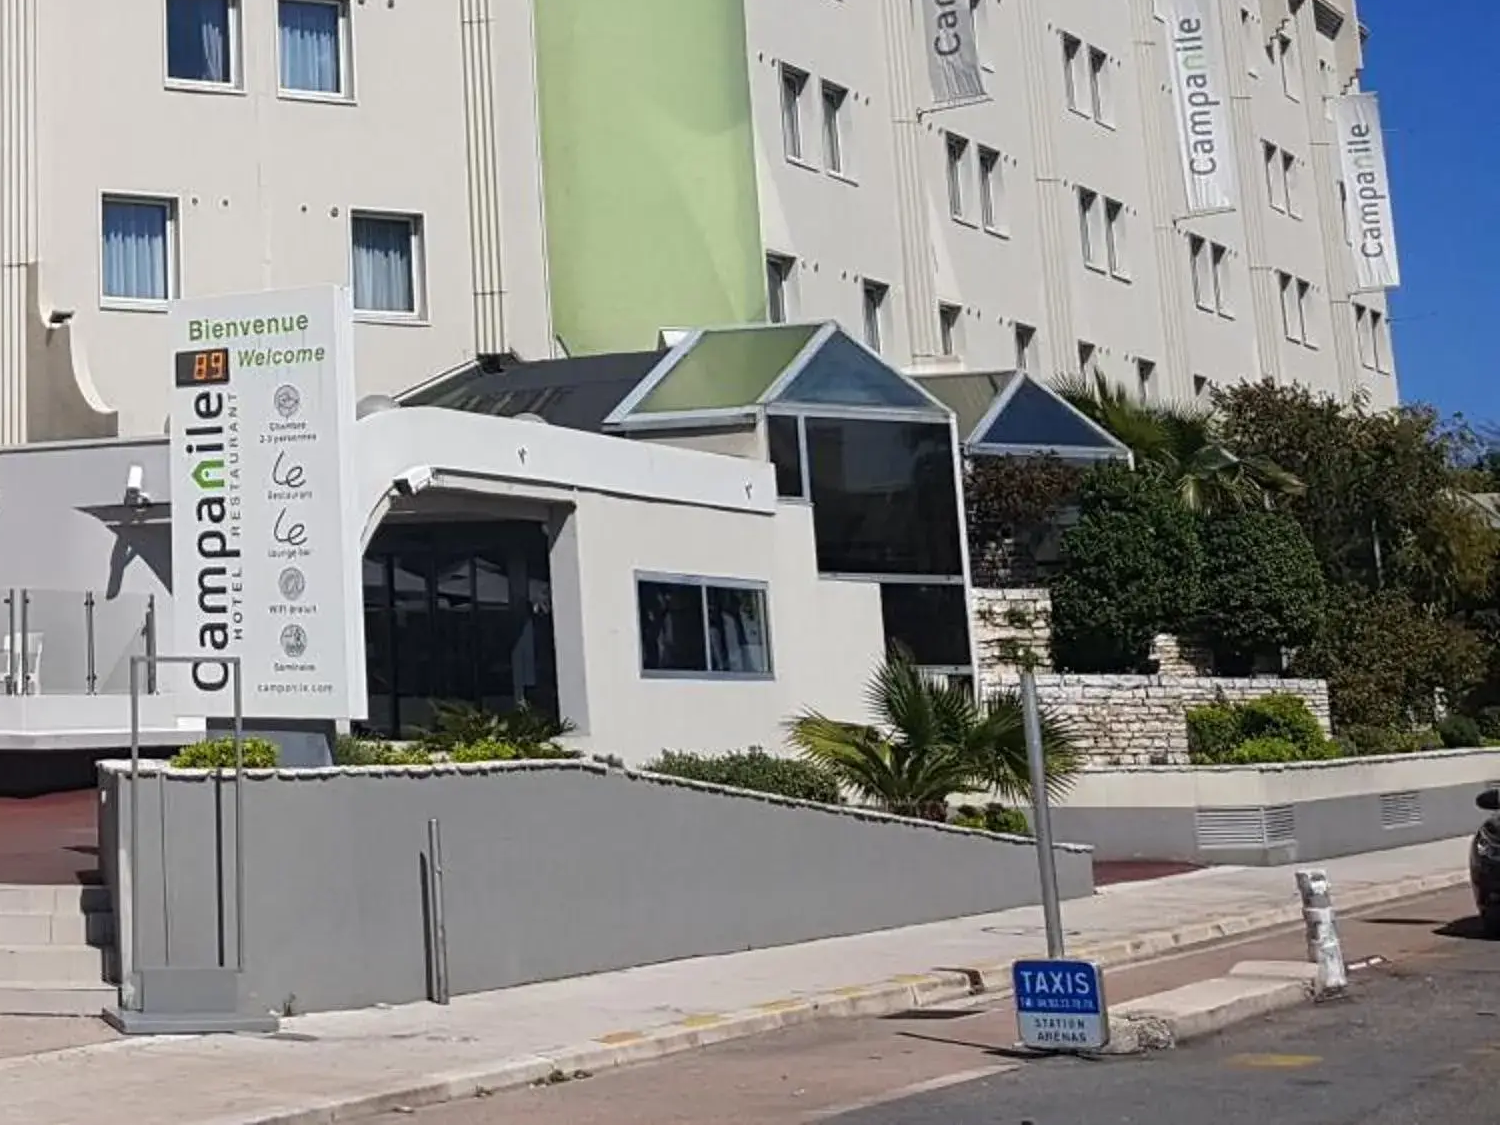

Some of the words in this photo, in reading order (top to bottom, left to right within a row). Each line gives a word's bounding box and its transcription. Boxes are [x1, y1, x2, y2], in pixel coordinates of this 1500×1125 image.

[1174, 18, 1220, 176] Campanile
[1348, 123, 1386, 258] Campanile
[188, 314, 309, 341] Bienvenue
[237, 347, 325, 367] Welcome
[226, 392, 241, 537] RESTAURANT
[185, 391, 240, 691] Campanile
[231, 567, 243, 640] HOTEL
[1020, 970, 1090, 995] TAXIS
[1034, 1018, 1085, 1029] STATION
